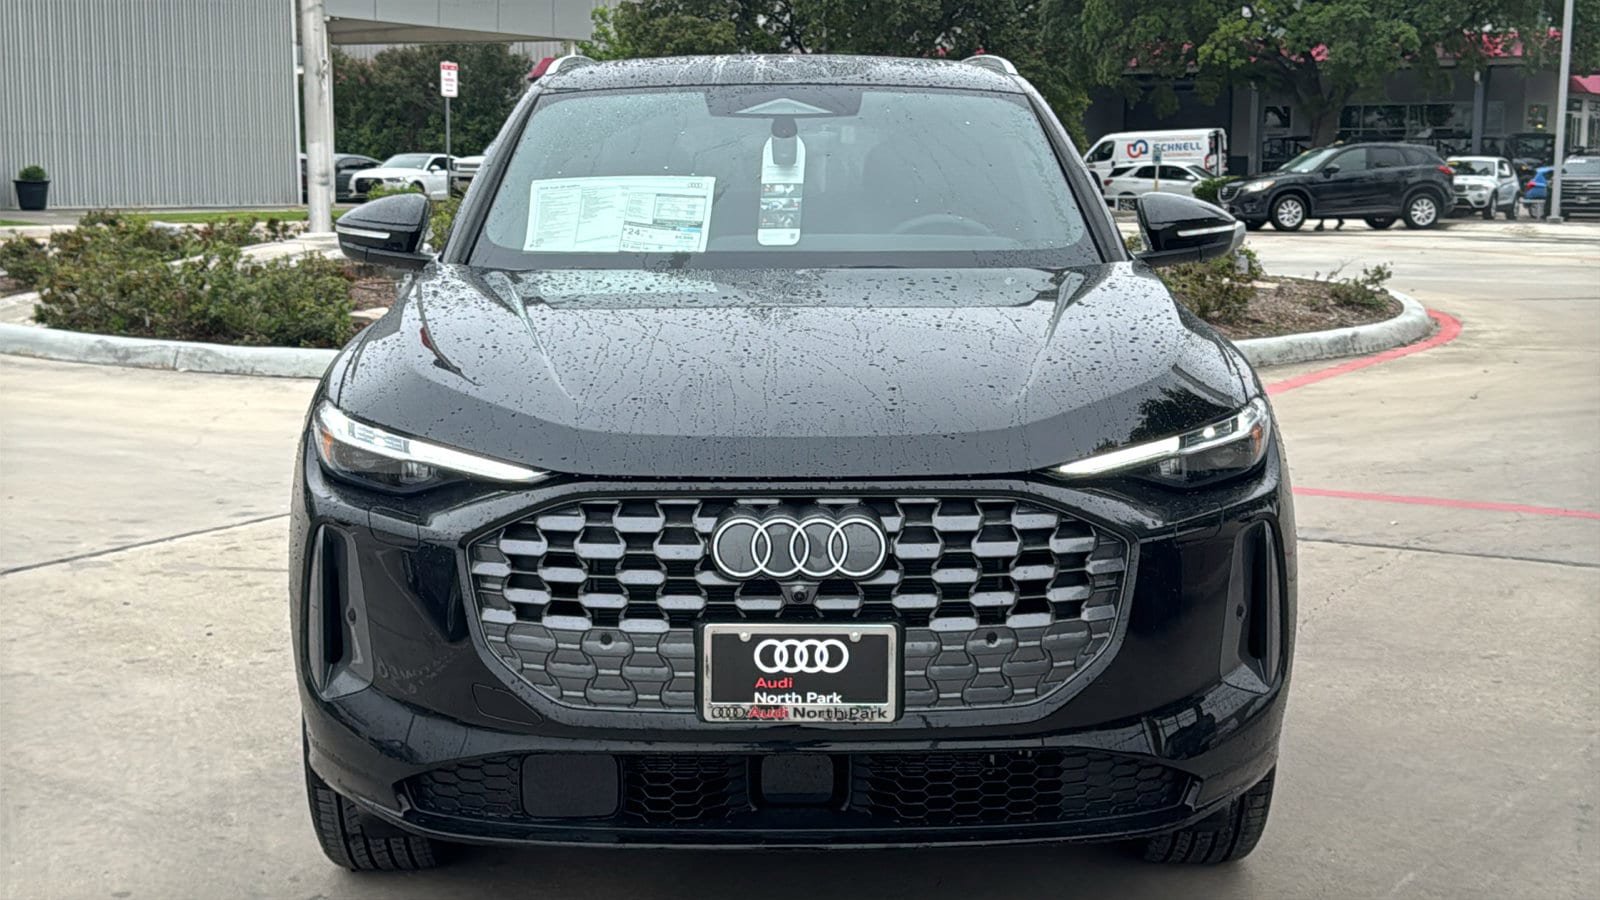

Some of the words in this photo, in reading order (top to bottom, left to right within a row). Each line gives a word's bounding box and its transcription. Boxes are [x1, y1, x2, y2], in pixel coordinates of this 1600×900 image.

[1152, 142, 1202, 152] SCHNELL
[755, 677, 794, 689] Audi
[754, 692, 801, 704] North
[806, 692, 842, 704] Park
[749, 707, 789, 719] Audi
[793, 706, 844, 719] North
[850, 706, 887, 719] Park
